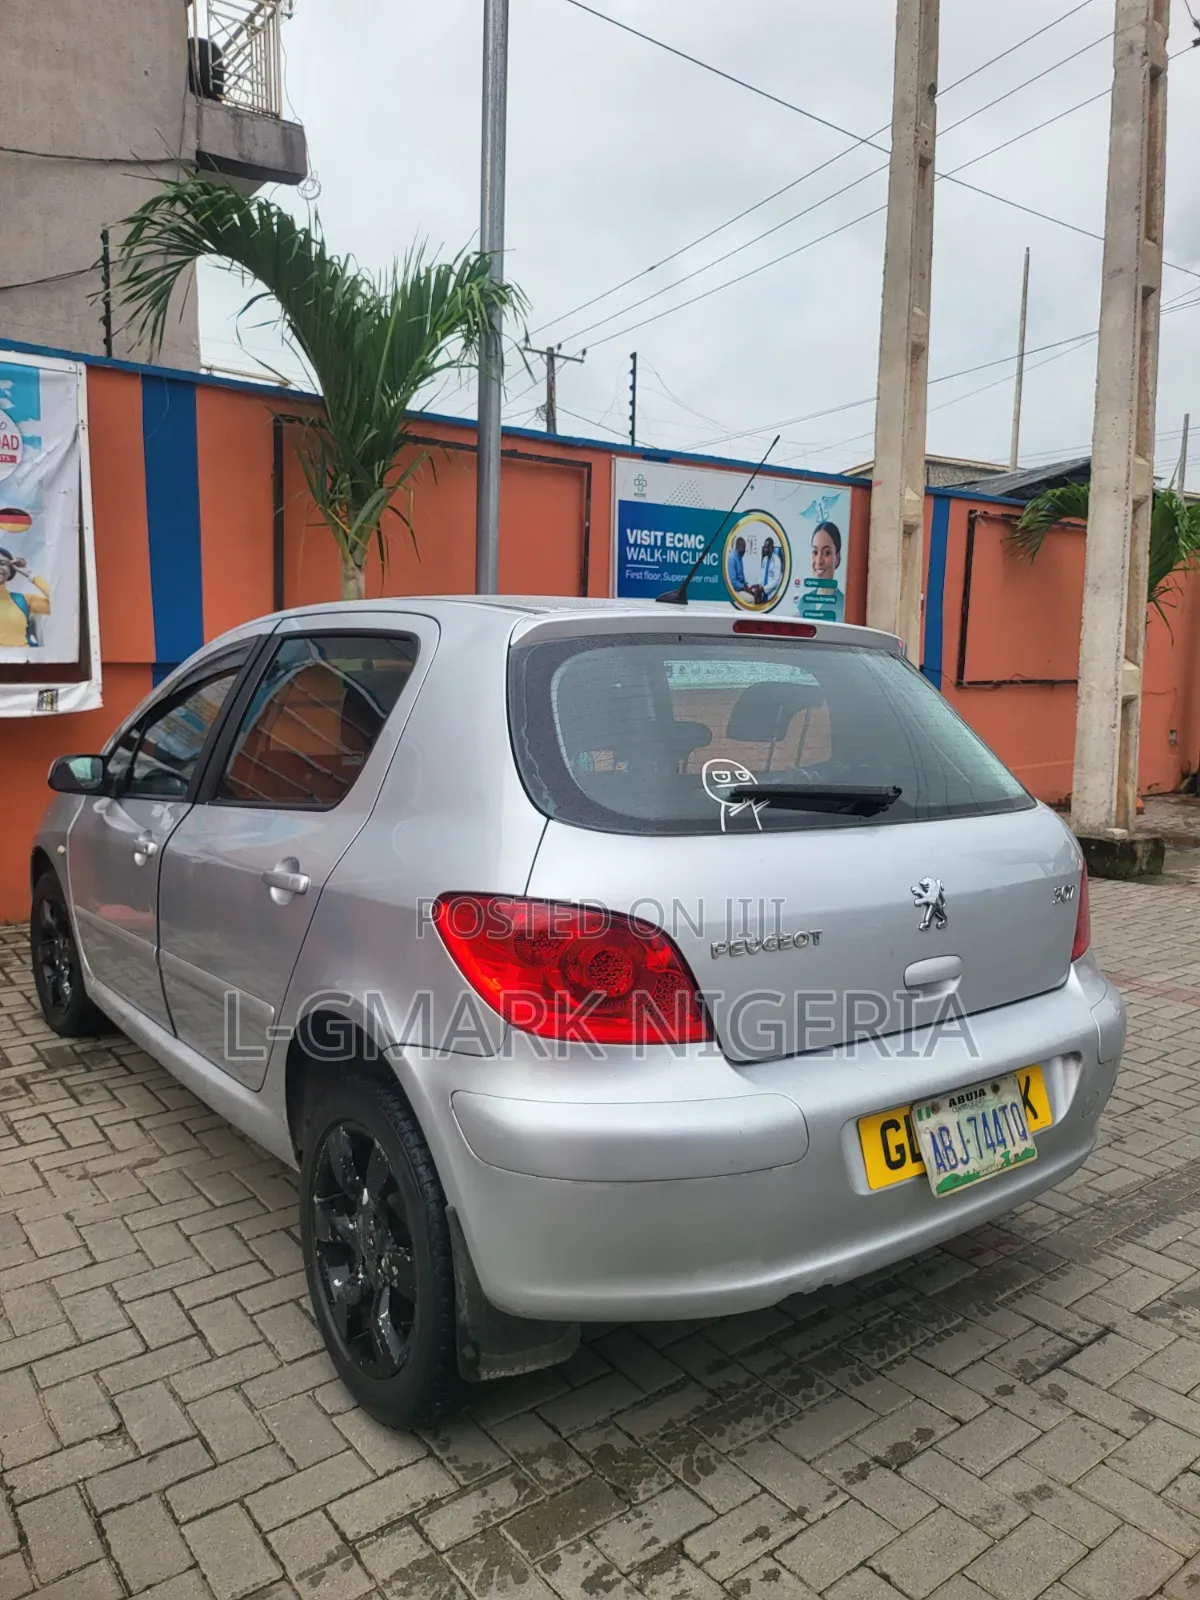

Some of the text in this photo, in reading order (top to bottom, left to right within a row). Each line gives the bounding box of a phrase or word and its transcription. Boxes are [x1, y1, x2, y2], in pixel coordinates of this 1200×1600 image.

[626, 528, 705, 550] VISIT ECMC
[626, 546, 679, 563] WALK-IN
[625, 569, 644, 581] First
[703, 574, 719, 584] mall
[1051, 884, 1077, 905] 307
[711, 928, 823, 960] PEUGEOT
[948, 1087, 987, 1108] ABUJA
